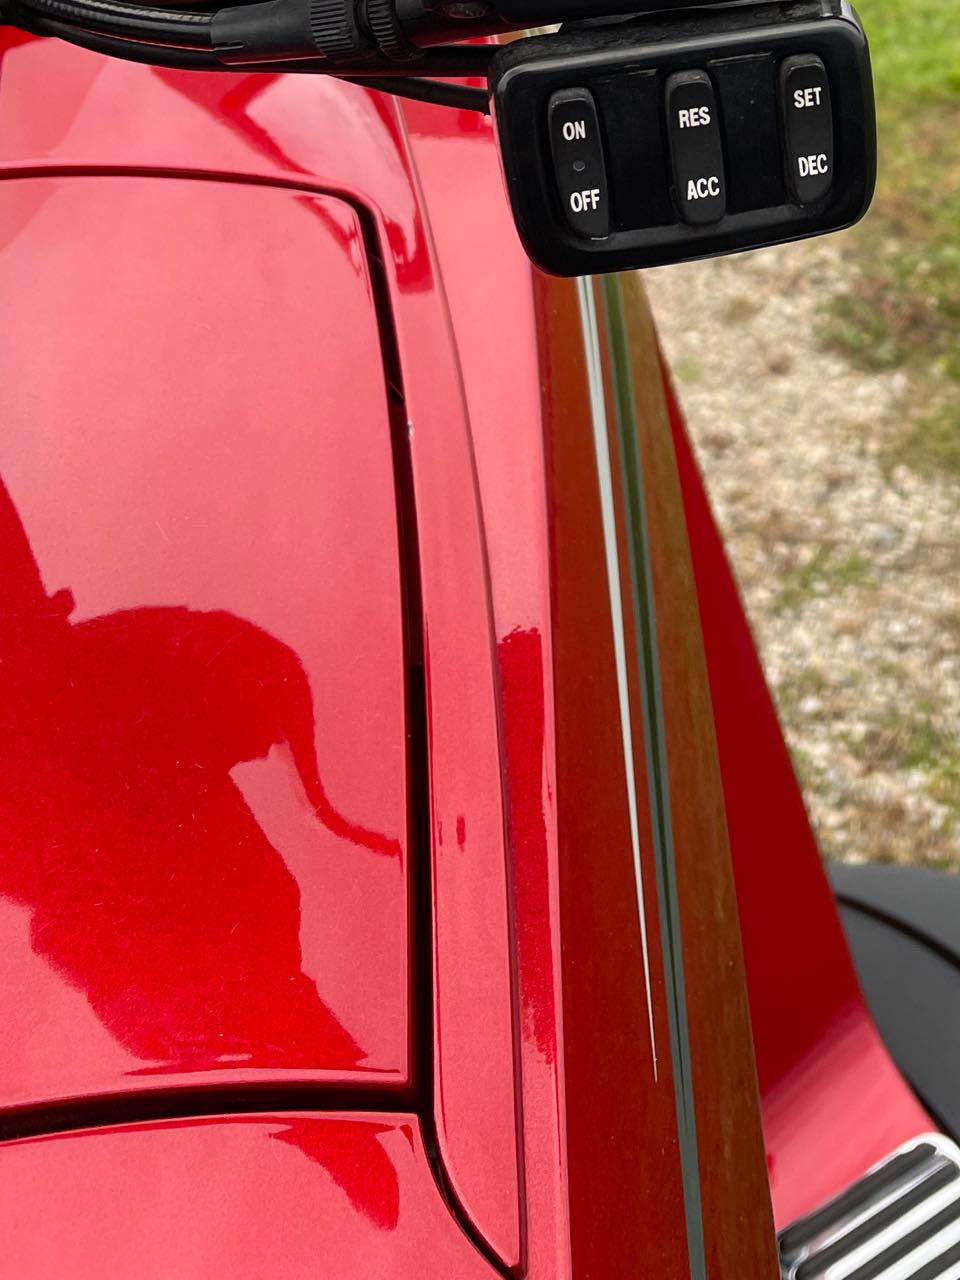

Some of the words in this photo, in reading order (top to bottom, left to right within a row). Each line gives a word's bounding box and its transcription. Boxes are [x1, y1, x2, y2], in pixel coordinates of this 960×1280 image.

[793, 87, 822, 109] SET
[678, 107, 711, 129] RES
[562, 120, 586, 141] ON
[797, 153, 828, 178] DEC
[686, 176, 720, 201] ACC
[569, 188, 600, 213] OFF
